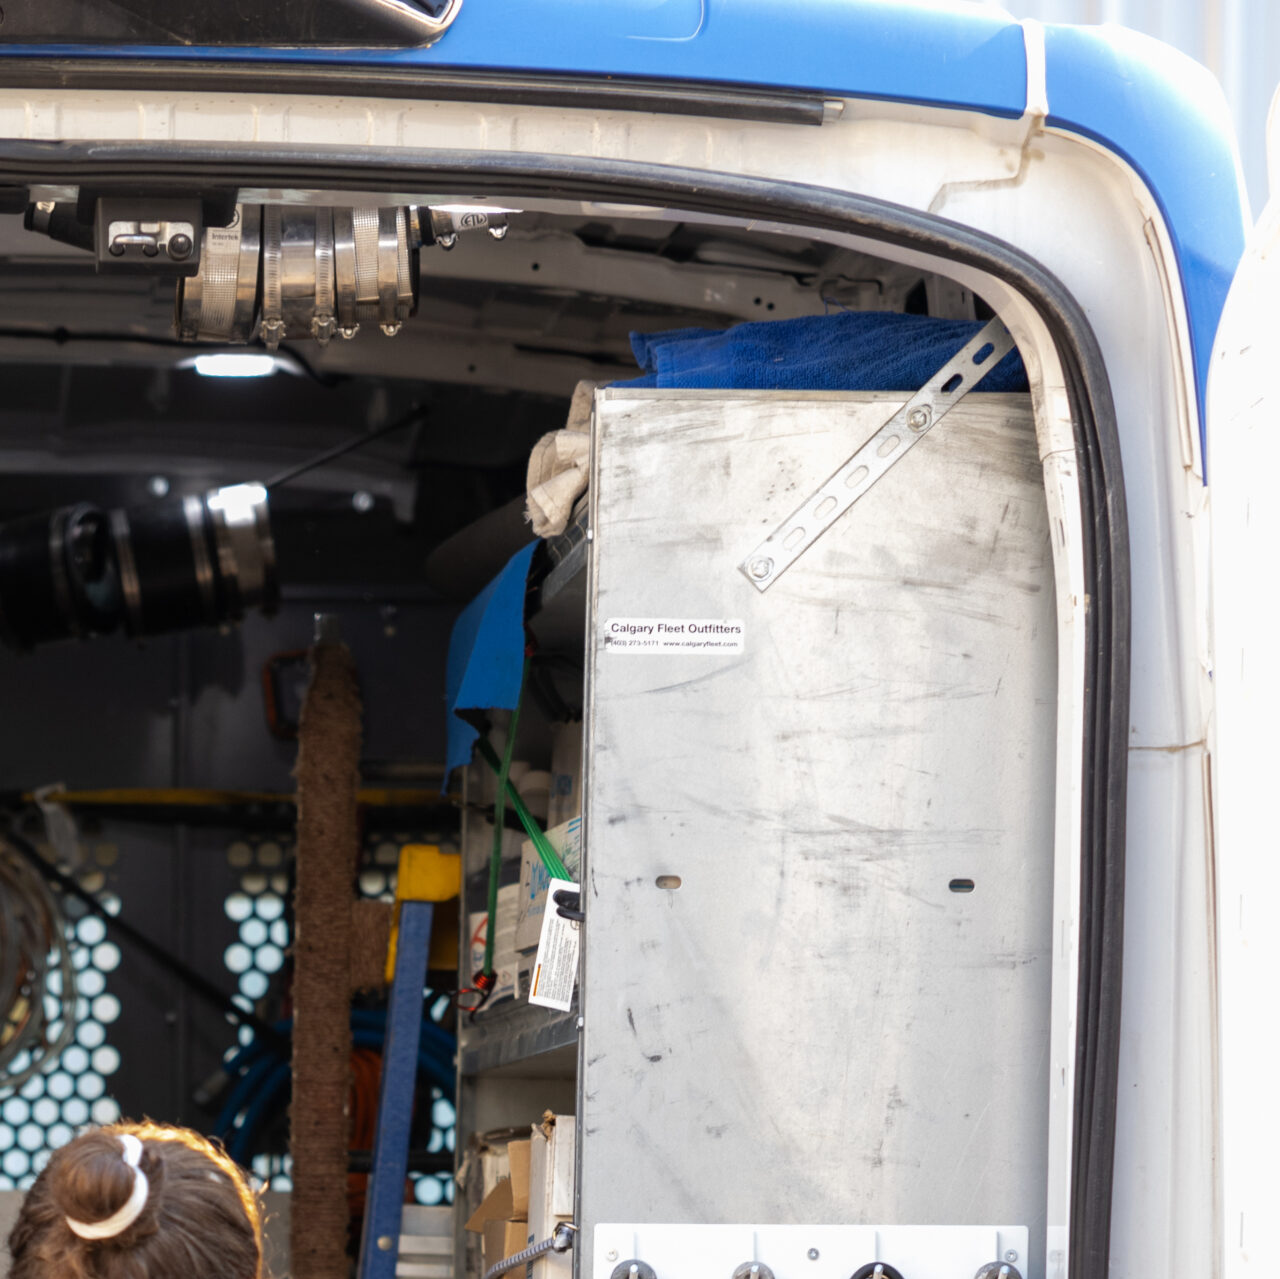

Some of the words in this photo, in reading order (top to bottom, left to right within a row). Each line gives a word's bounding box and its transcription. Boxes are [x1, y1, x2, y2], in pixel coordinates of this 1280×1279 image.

[212, 233, 239, 241] Intertek
[611, 622, 654, 634] Calgary
[658, 623, 685, 633] Fleet
[688, 623, 741, 633] Outfitters
[663, 640, 739, 648] www.calgaryfleet.com
